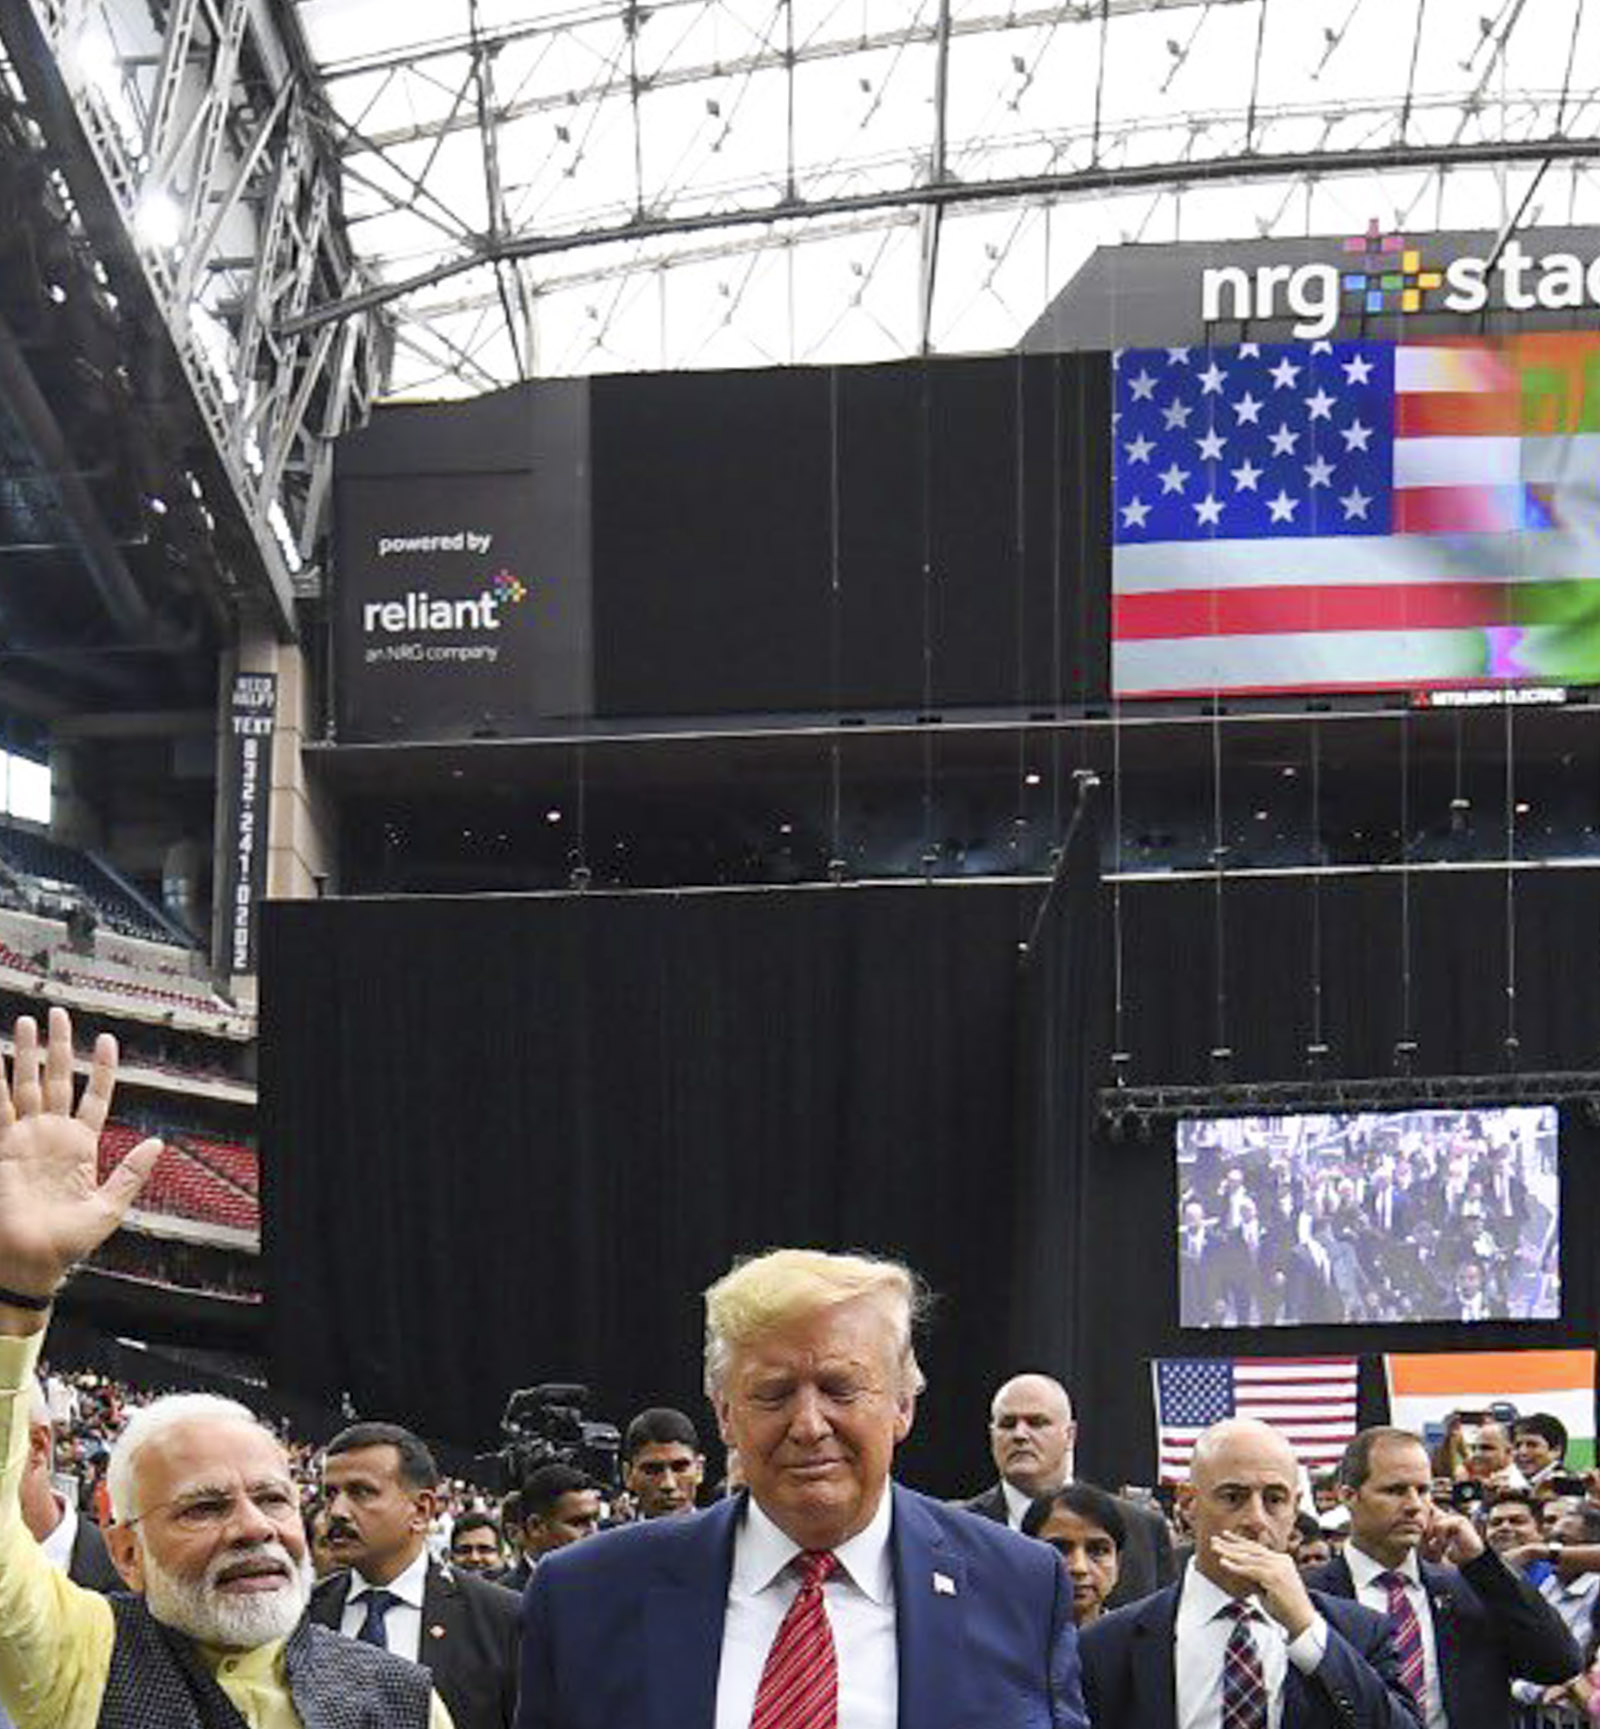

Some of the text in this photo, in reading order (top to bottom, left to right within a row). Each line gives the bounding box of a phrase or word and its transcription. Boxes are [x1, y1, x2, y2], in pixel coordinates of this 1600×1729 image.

[1201, 261, 1339, 339] nrg
[379, 531, 492, 557] powered by
[364, 591, 500, 632] reliant
[426, 644, 499, 662] company
